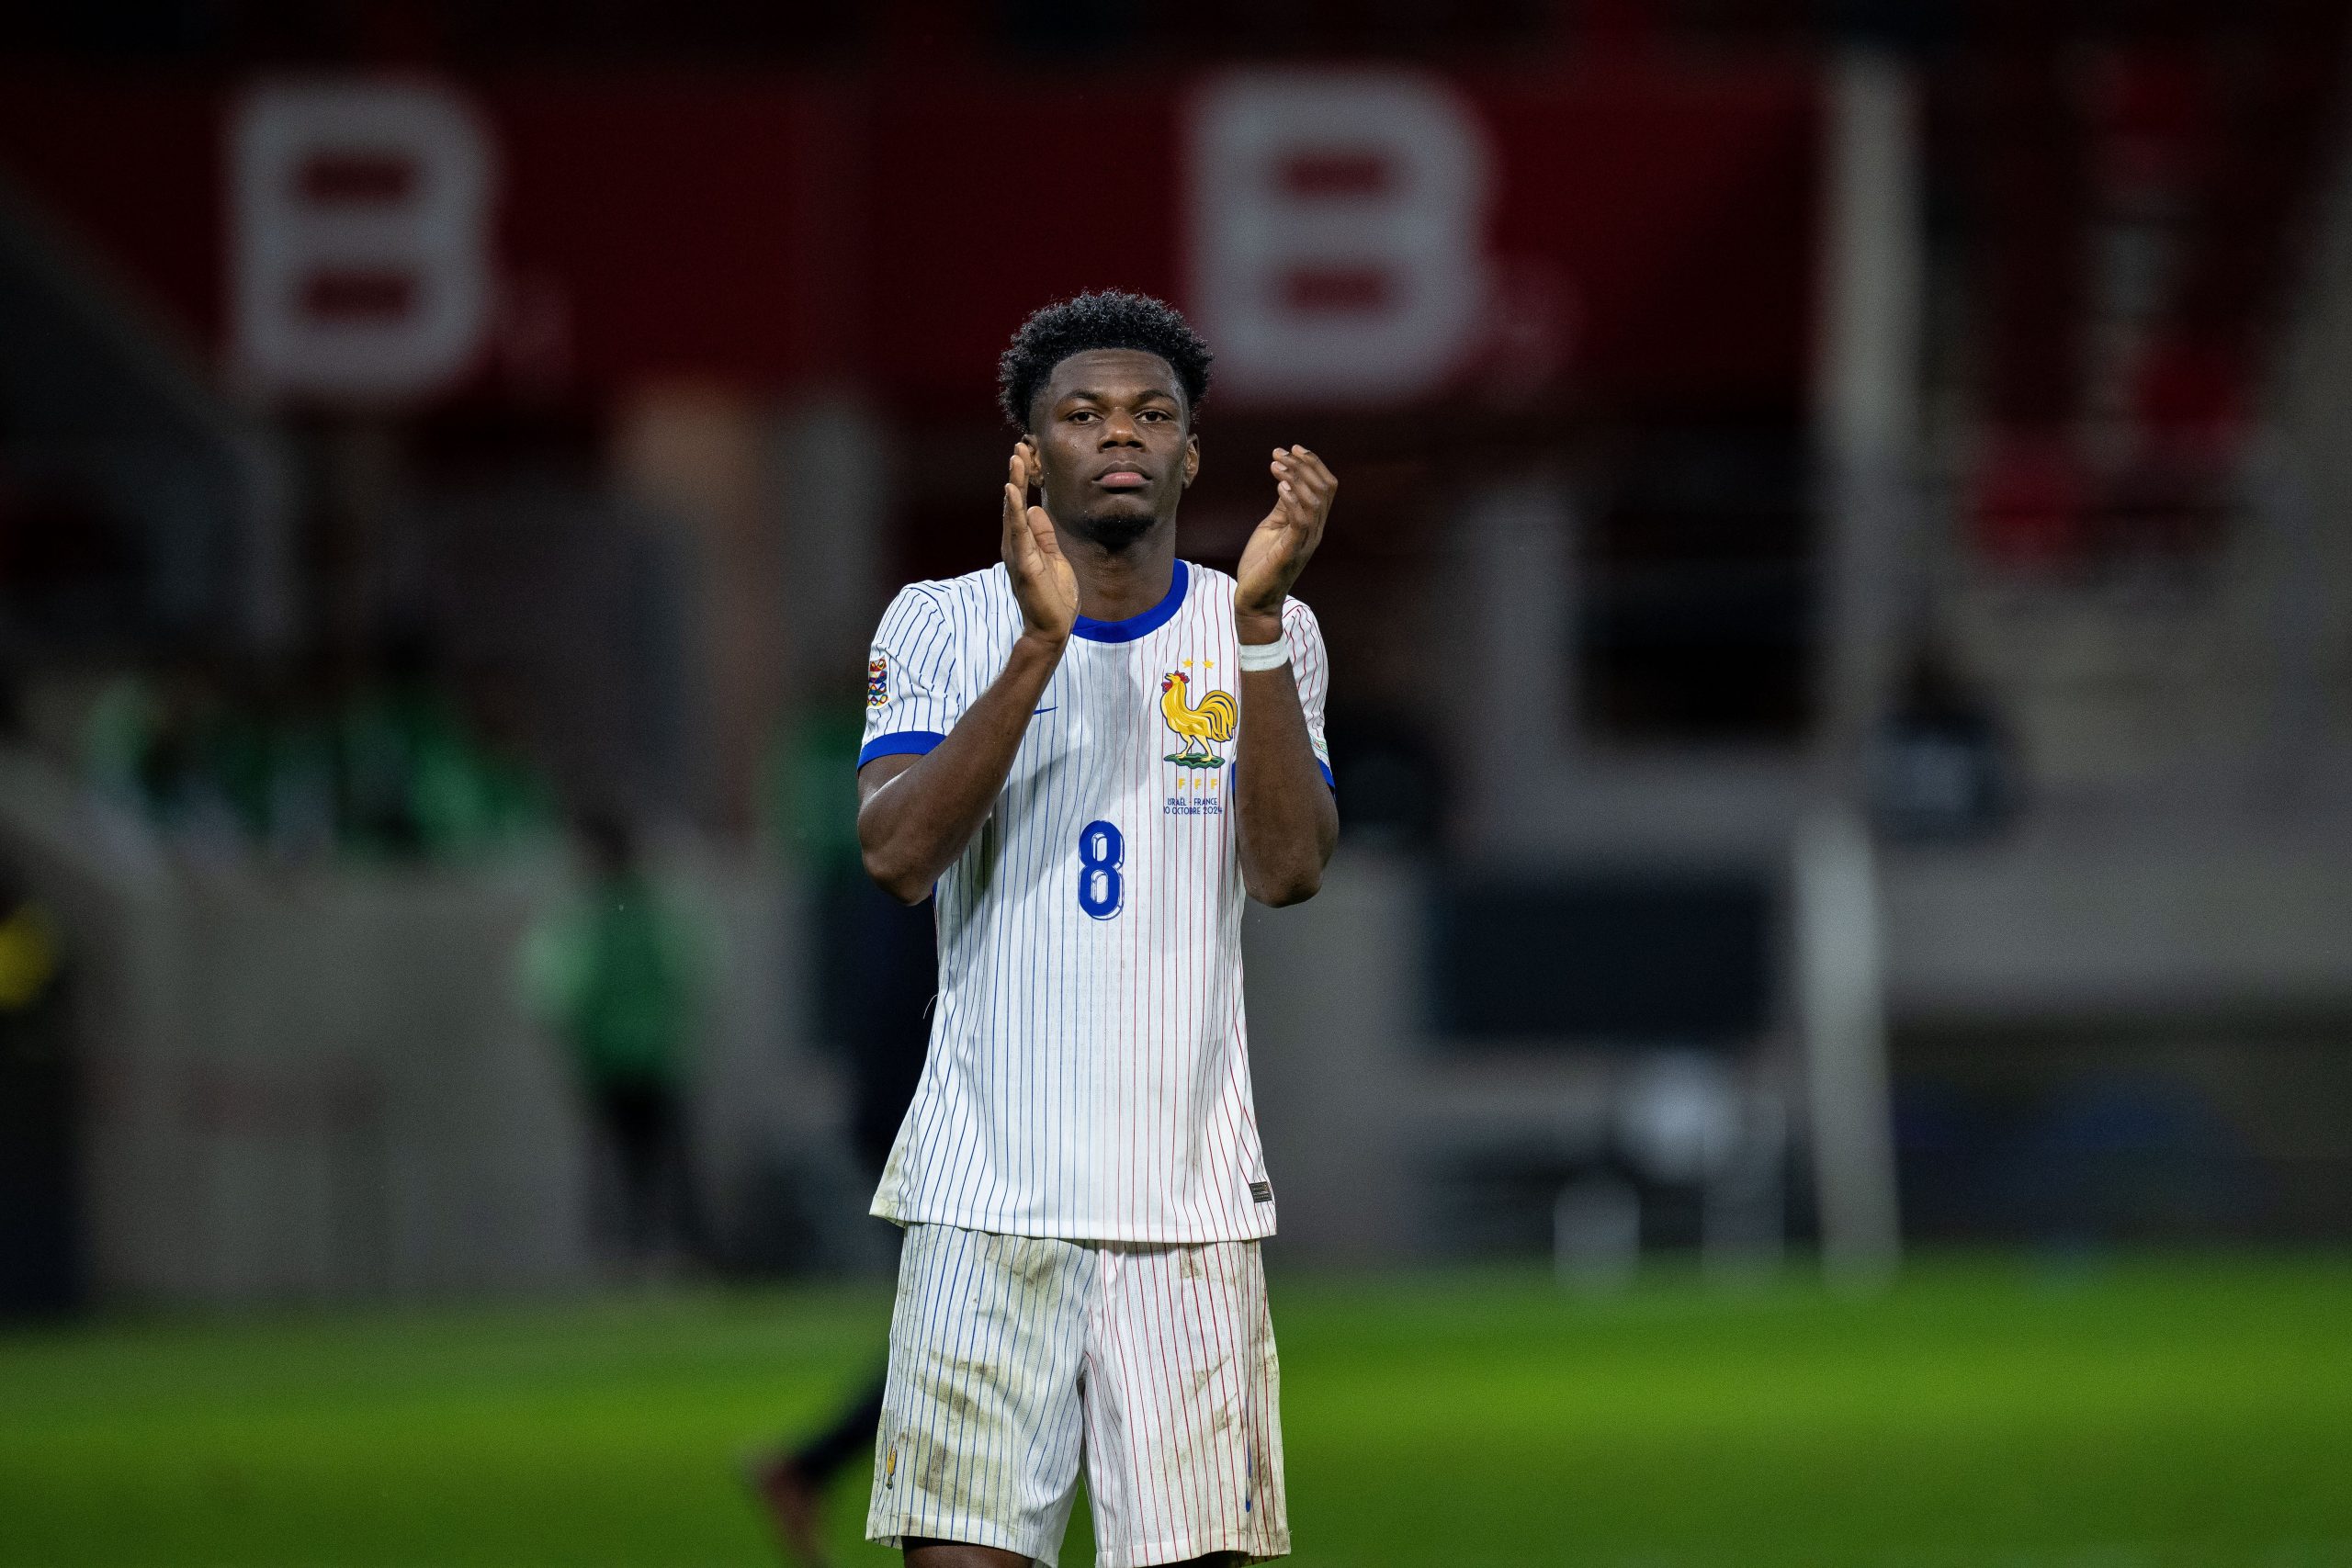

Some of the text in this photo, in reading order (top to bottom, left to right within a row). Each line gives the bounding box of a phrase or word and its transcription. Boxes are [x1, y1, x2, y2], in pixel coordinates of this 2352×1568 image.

[226, 75, 503, 399] B
[1183, 73, 1501, 399] B
[1172, 807, 1200, 815] OCTOBRE
[1204, 807, 1223, 815] 2024
[1194, 797, 1217, 806] FRANCE
[1079, 819, 1125, 920] 8
